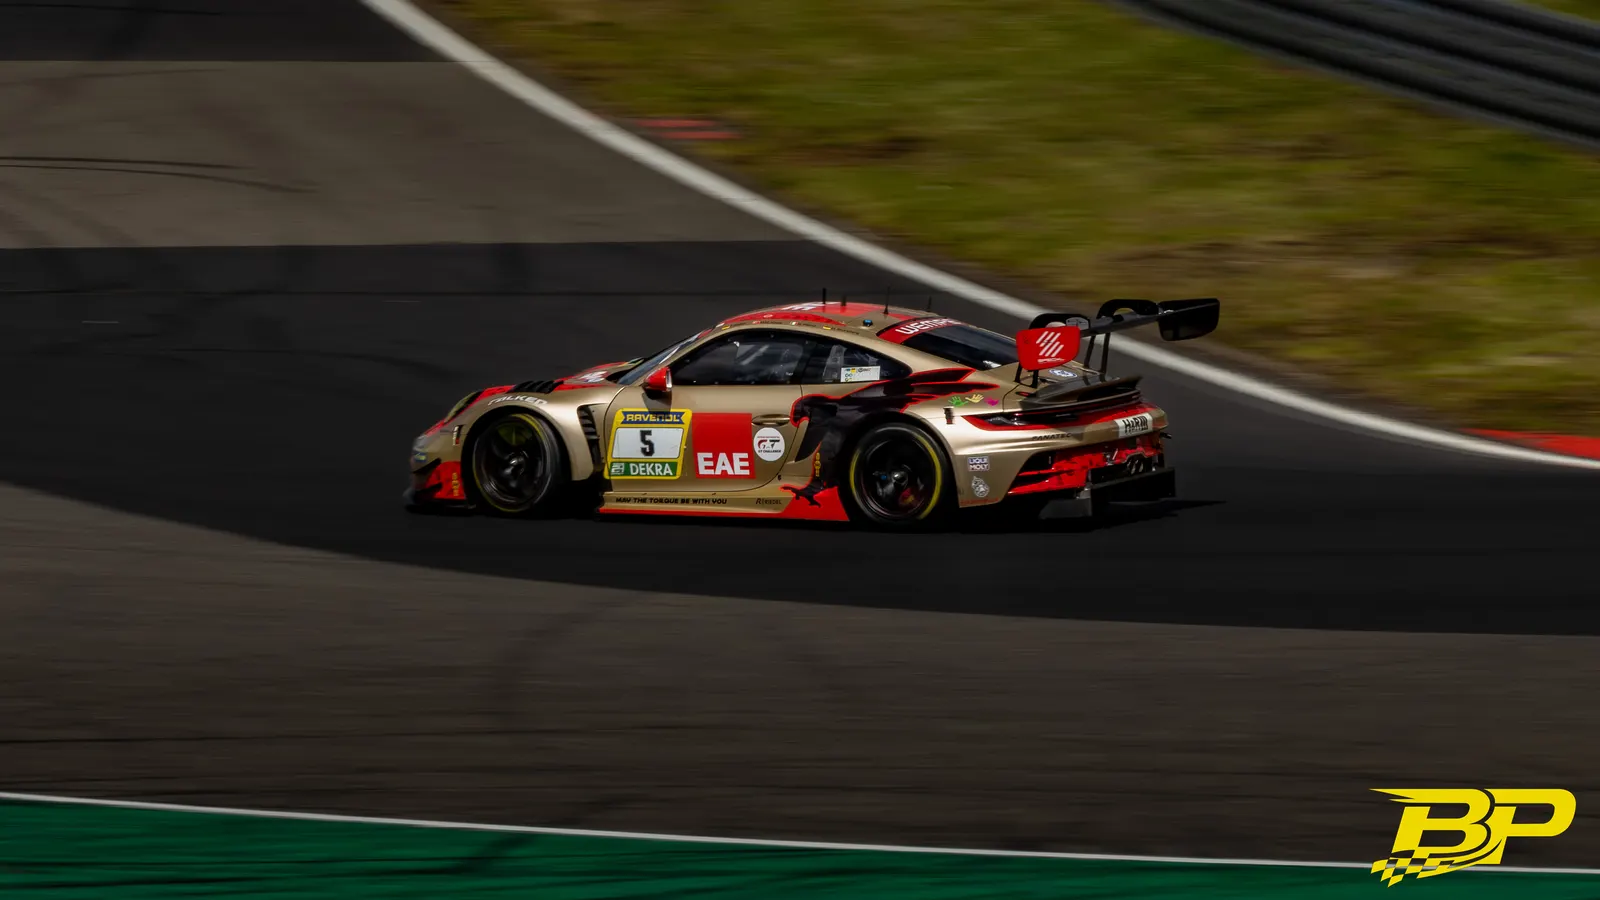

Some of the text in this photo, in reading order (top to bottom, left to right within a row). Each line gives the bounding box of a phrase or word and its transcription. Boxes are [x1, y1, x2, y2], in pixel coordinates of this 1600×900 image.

[626, 413, 680, 423] RAVENOL
[640, 430, 655, 457] 5
[629, 462, 673, 476] DEKRA
[697, 452, 750, 476] EAE
